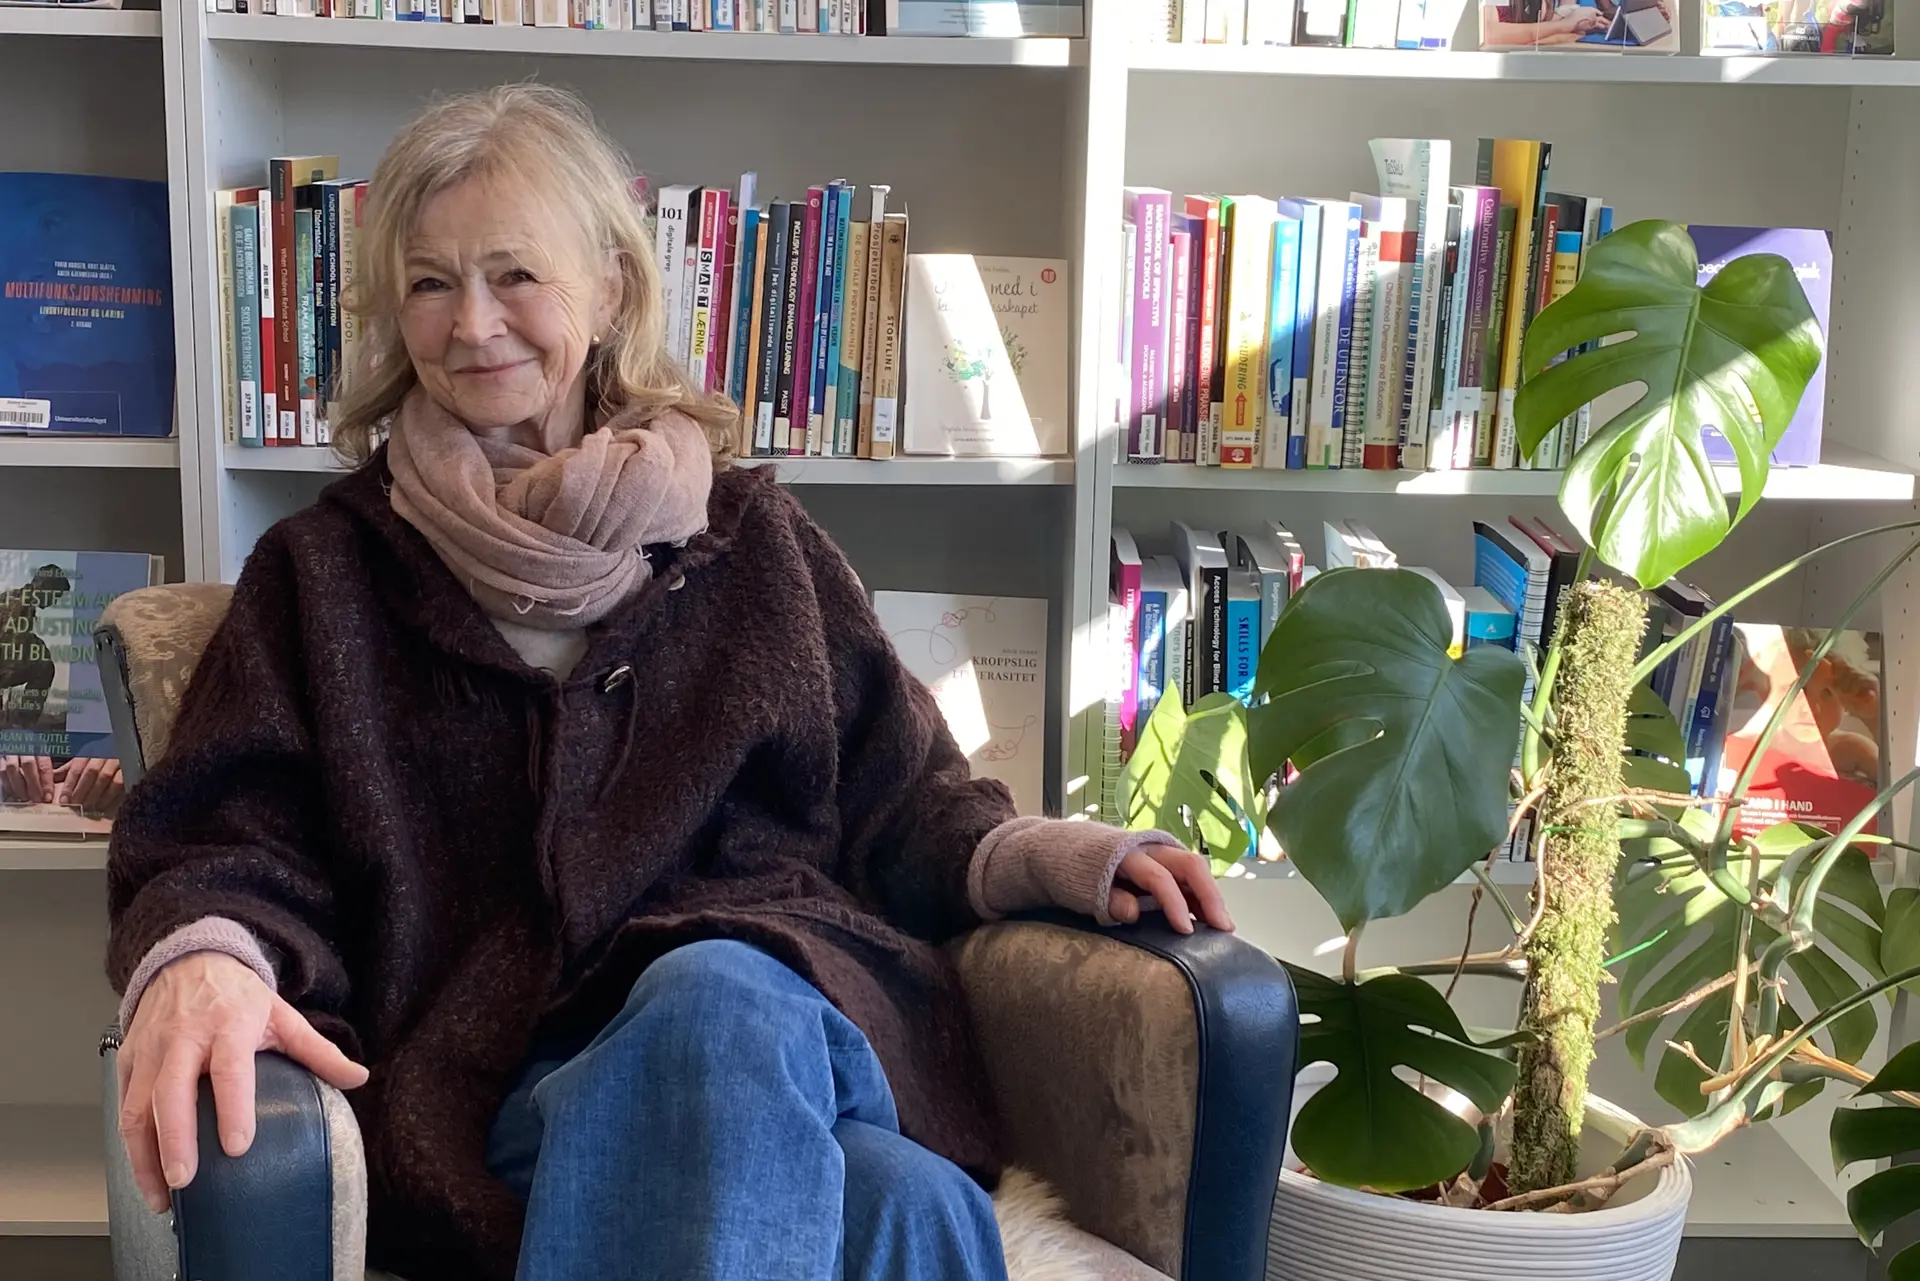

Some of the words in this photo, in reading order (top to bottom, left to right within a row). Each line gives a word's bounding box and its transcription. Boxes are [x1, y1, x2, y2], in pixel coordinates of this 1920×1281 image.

[328, 194, 336, 251] UNDERSTANDING
[660, 207, 683, 220] 101
[1144, 204, 1153, 254] INCLUSIVE
[235, 231, 243, 243] OLE
[244, 228, 253, 250] GAUTE
[313, 209, 323, 258] Understanding
[343, 208, 352, 255] ABSENT
[665, 225, 675, 253] digitale
[792, 220, 801, 255] INCLUSIVE
[855, 234, 861, 246] DE
[1154, 204, 1164, 260] HANDBOOK
[1479, 198, 1495, 264] Collaborative
[235, 245, 244, 267] JACOB
[664, 254, 673, 272] grep
[868, 223, 881, 301] Prosjektarbeid
[1153, 261, 1161, 275] OF
[1492, 238, 1502, 291] Developmental
[1501, 231, 1511, 275] International
[236, 268, 245, 297] MADSEN
[244, 251, 255, 295] BROCHMANN
[697, 251, 712, 308] SMART
[771, 274, 779, 286] Det
[789, 257, 798, 302] TECHNOLOGY
[852, 250, 861, 288] DIGITALE
[1142, 256, 1152, 299] SCHOOLS
[1426, 264, 1437, 293] Sensory
[5, 282, 162, 305] MULTIFUNKSJONSHEMMING
[316, 282, 324, 306] Refusal
[990, 275, 1023, 296] med
[1030, 281, 1038, 297] i
[1151, 277, 1160, 326] EFFECTIVE
[1396, 274, 1405, 305] Juvenile
[1473, 267, 1487, 323] Assessment
[1498, 276, 1507, 300] Review
[91, 309, 100, 318] OG
[101, 309, 124, 319] LÆRING
[329, 283, 337, 327] TRANSITION
[1384, 282, 1394, 322] Childhood
[1425, 296, 1433, 327] Learners
[282, 320, 290, 343] School
[345, 298, 353, 344] SHOOL
[695, 312, 706, 354] LÆRING
[767, 289, 778, 347] digitaliserade
[786, 303, 794, 340] ENHANCED
[848, 289, 858, 361] PRØVEKANINENE
[1393, 307, 1403, 343] Neuronal
[885, 316, 895, 371] STORYLINE
[1339, 327, 1352, 345] DE
[1380, 325, 1390, 363] Dementia
[1469, 332, 1478, 361] Goodman
[783, 341, 792, 374] LEARNING
[1421, 344, 1429, 362] Edition
[764, 350, 773, 394] klassrummet
[1333, 349, 1350, 414] UTENFOR
[1379, 364, 1387, 379] and
[780, 390, 788, 415] PASSEY
[1199, 388, 1209, 422] PRAKSIS
[1376, 381, 1386, 420] Education
[1213, 575, 1221, 603] Access
[1270, 582, 1281, 621] Beginning
[1144, 614, 1152, 639] Children
[1173, 624, 1182, 651] tners
[1211, 604, 1221, 649] Technology
[1238, 617, 1249, 652] SKILLS
[0, 643, 26, 664] TH
[29, 644, 97, 664] BLINDN
[973, 656, 1037, 668] KROPPSLIG
[1172, 655, 1181, 664] in
[1213, 650, 1221, 661] for
[1238, 657, 1249, 677] FOR
[953, 669, 1037, 683] LIERASITET
[1213, 663, 1221, 683] Blind
[19, 701, 41, 713] Life's
[39, 733, 70, 748] TUTTLE
[40, 746, 71, 760] TUTTLE
[1781, 800, 1813, 812] HAND
